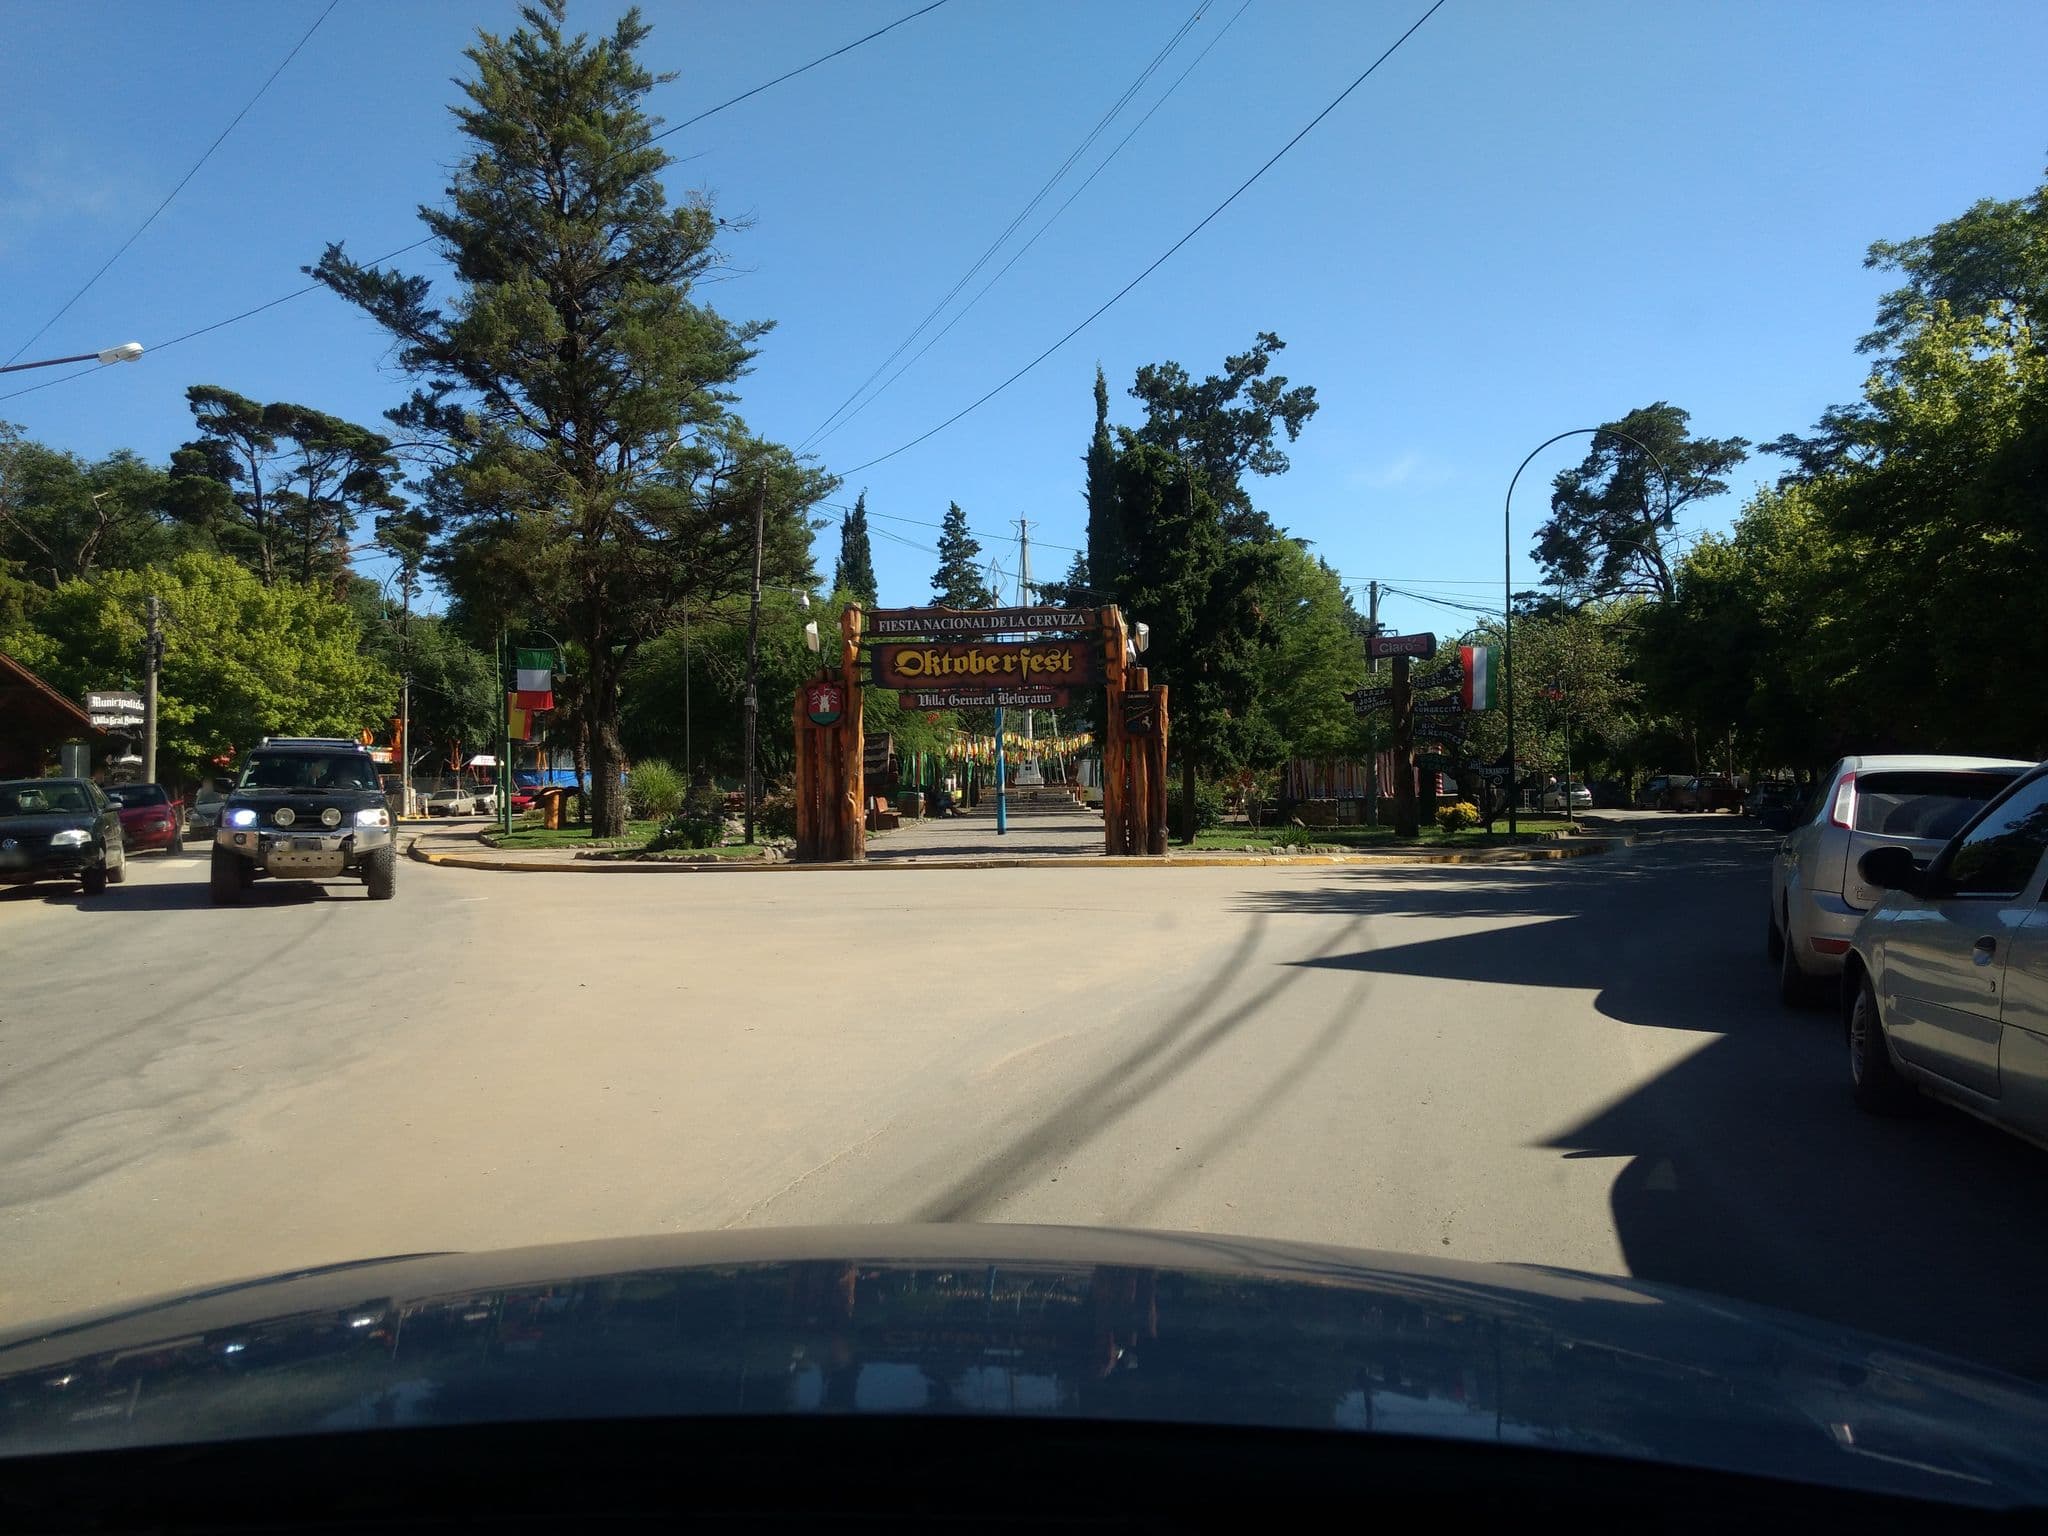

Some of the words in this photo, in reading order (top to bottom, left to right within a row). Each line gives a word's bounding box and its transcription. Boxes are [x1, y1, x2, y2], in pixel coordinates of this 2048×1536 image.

[879, 619, 920, 632] FIESTA
[923, 617, 990, 631] NACIONAL
[991, 616, 1009, 628] DE
[1010, 616, 1026, 627] LA
[1027, 614, 1085, 627] CERVEZA
[1379, 642, 1413, 653] Claro
[894, 648, 1073, 680] Oktoberfest
[91, 696, 144, 710] Municipalida
[918, 693, 946, 706] Villa
[948, 693, 994, 706] General
[998, 692, 1052, 707] Belgrano
